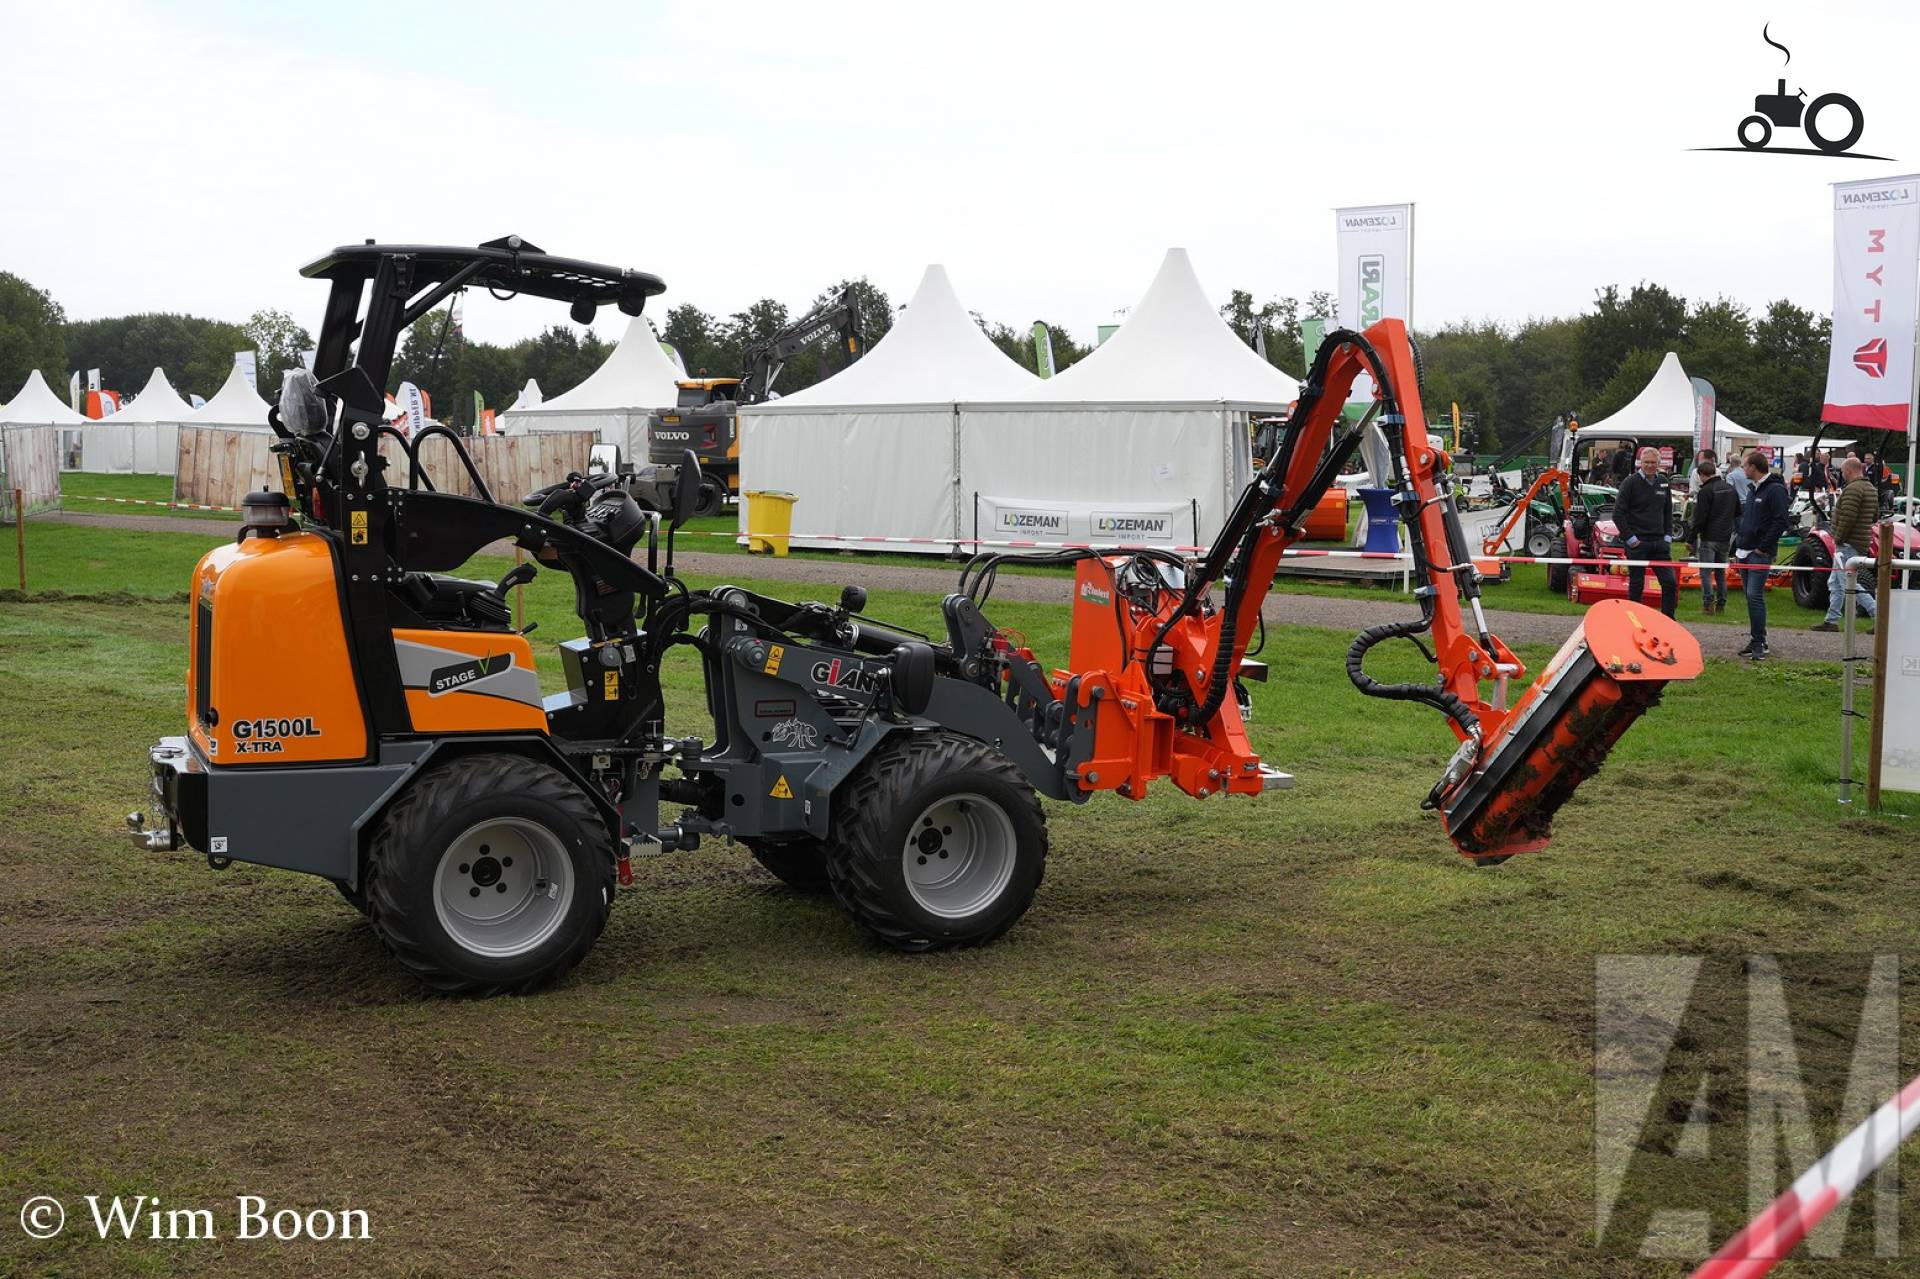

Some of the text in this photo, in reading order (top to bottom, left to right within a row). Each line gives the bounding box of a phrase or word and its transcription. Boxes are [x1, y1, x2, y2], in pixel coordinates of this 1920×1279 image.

[800, 323, 831, 345] VOLVO
[655, 431, 690, 441] VOLVO
[1003, 513, 1059, 528] LOZEMAN
[1098, 518, 1164, 532] LOZEMAN
[436, 669, 477, 690] STAGE
[232, 716, 322, 739] G1500L
[235, 740, 284, 754] X-TRA
